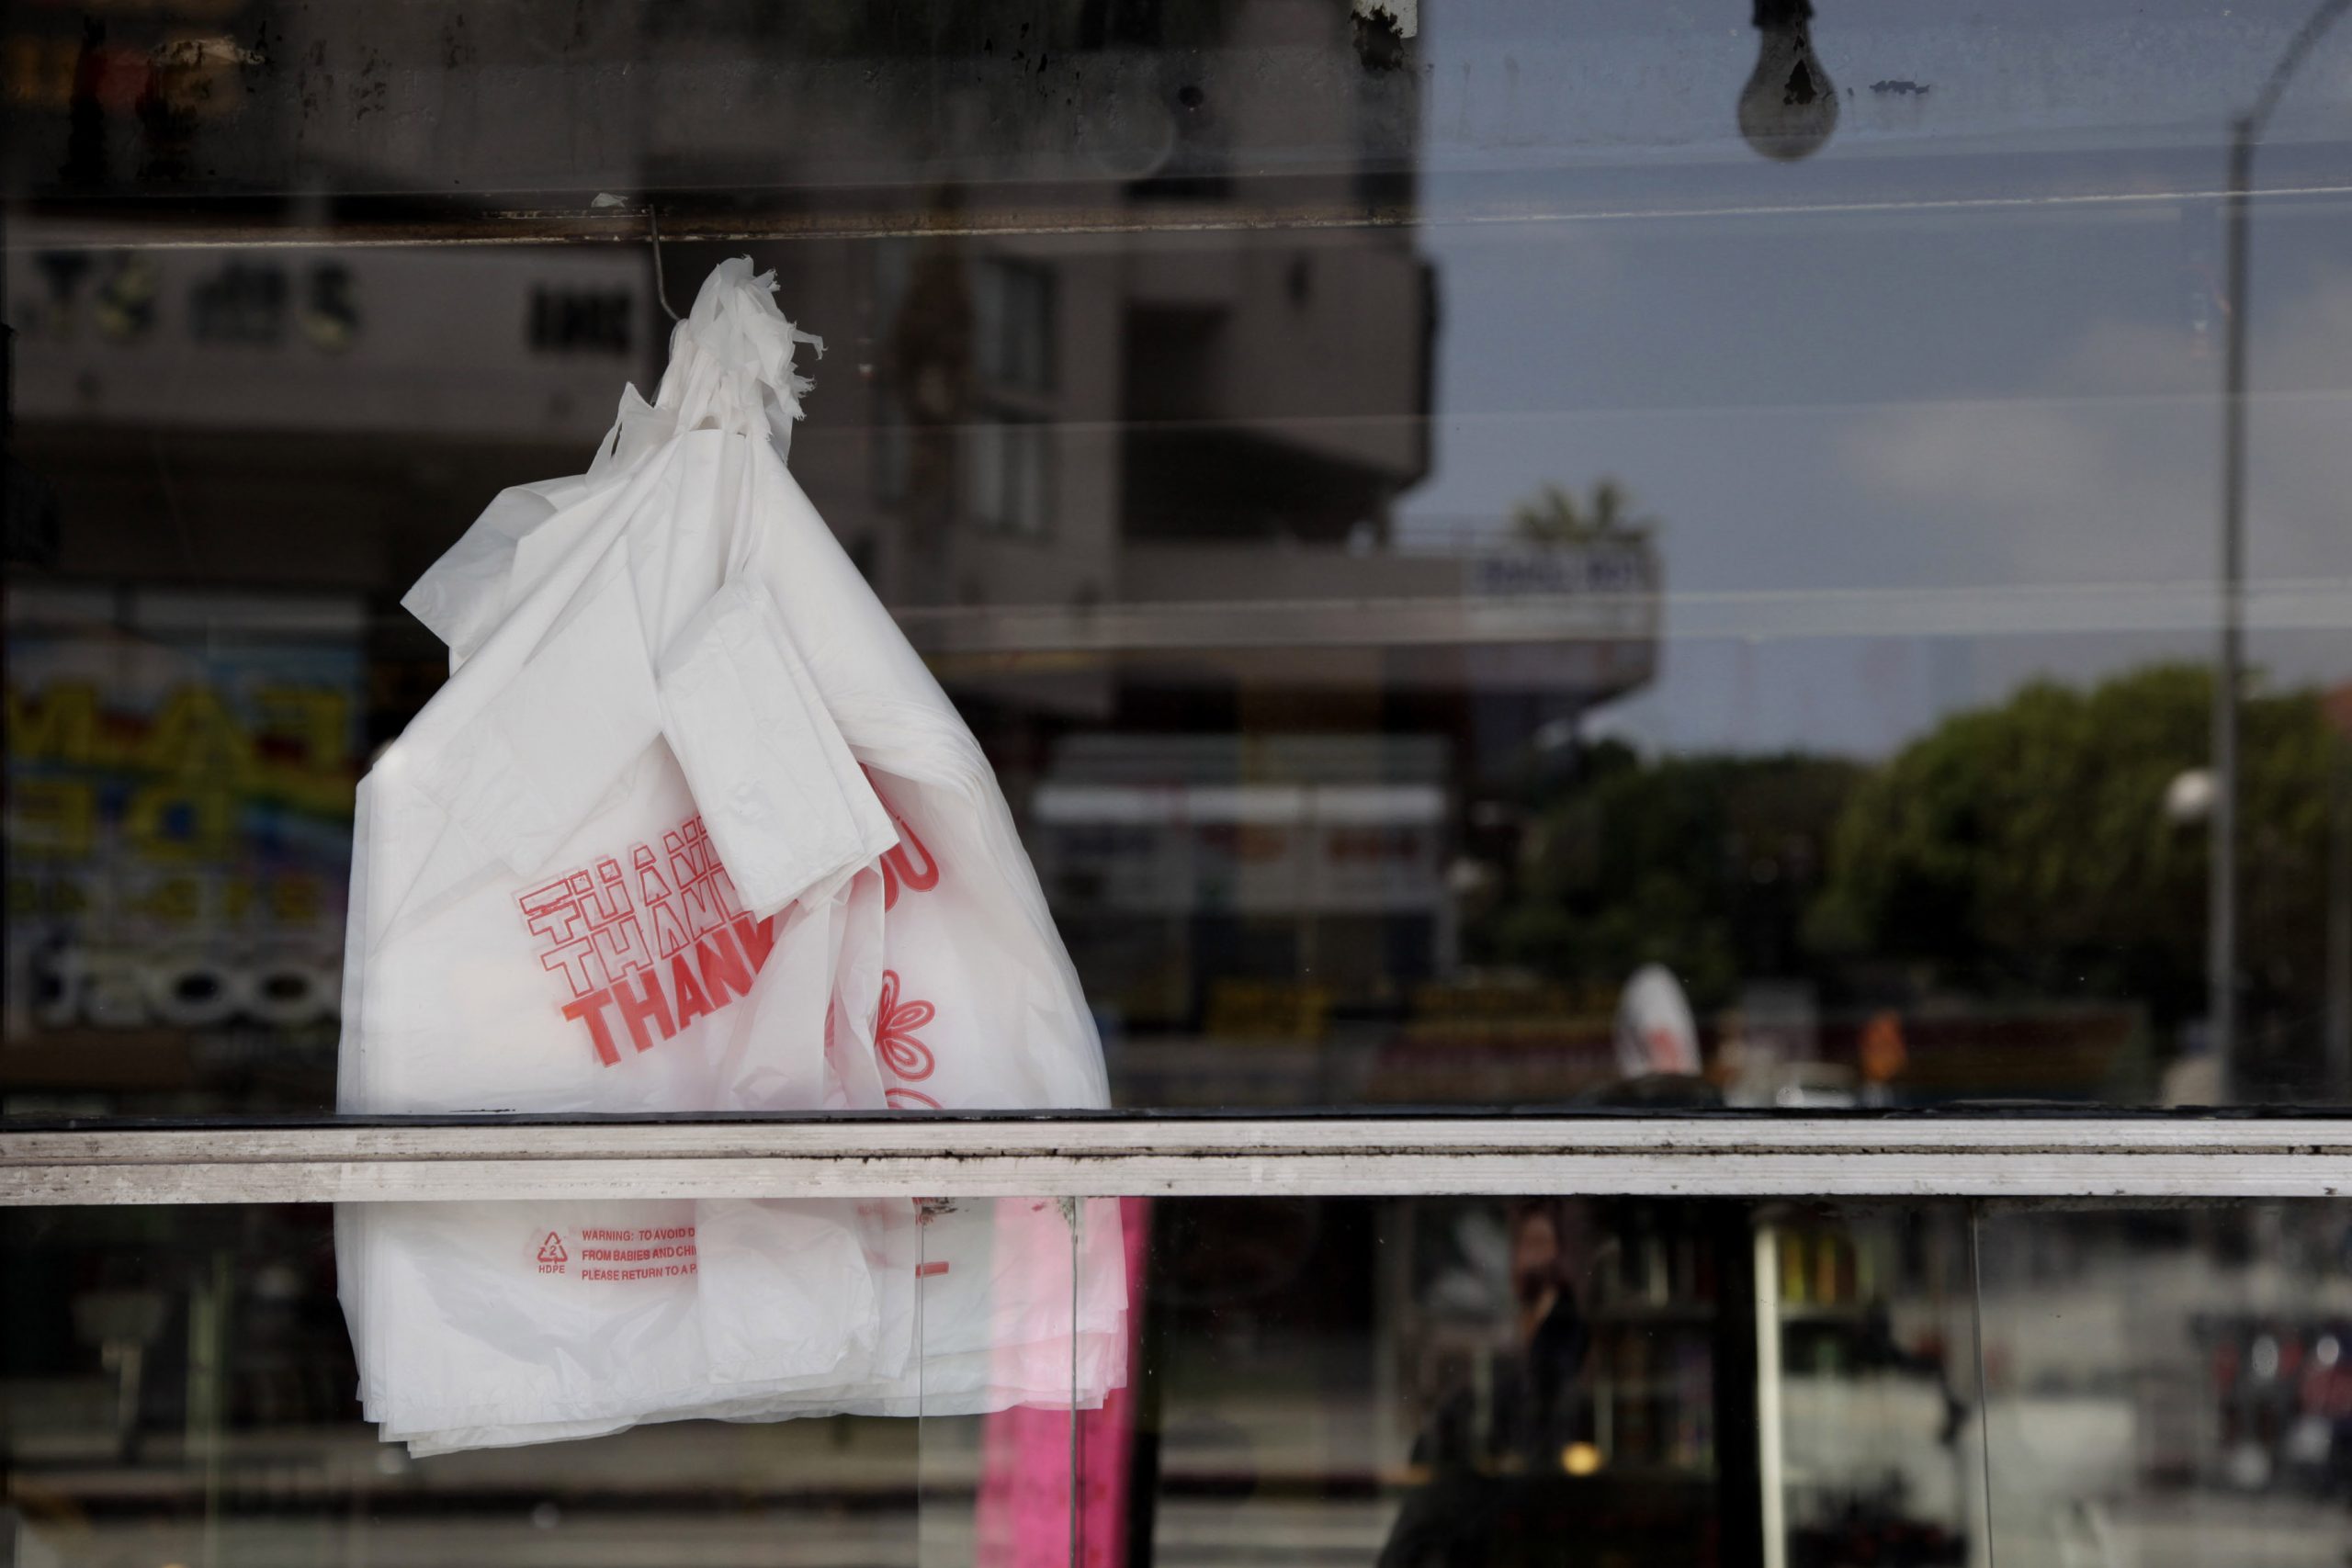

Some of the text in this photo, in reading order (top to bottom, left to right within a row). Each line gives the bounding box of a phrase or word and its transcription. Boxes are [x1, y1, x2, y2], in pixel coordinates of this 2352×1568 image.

[582, 1229, 634, 1242] WARNING:
[639, 1230, 652, 1241] TO
[654, 1227, 686, 1240] AVOID
[582, 1249, 612, 1261] FROM
[613, 1249, 650, 1261] BABIES
[652, 1247, 674, 1259] AND
[538, 1264, 565, 1274] HDPE
[582, 1269, 619, 1281] PLEASE
[621, 1268, 662, 1280] RETURN
[664, 1266, 678, 1276] TO
[680, 1265, 687, 1275] A
